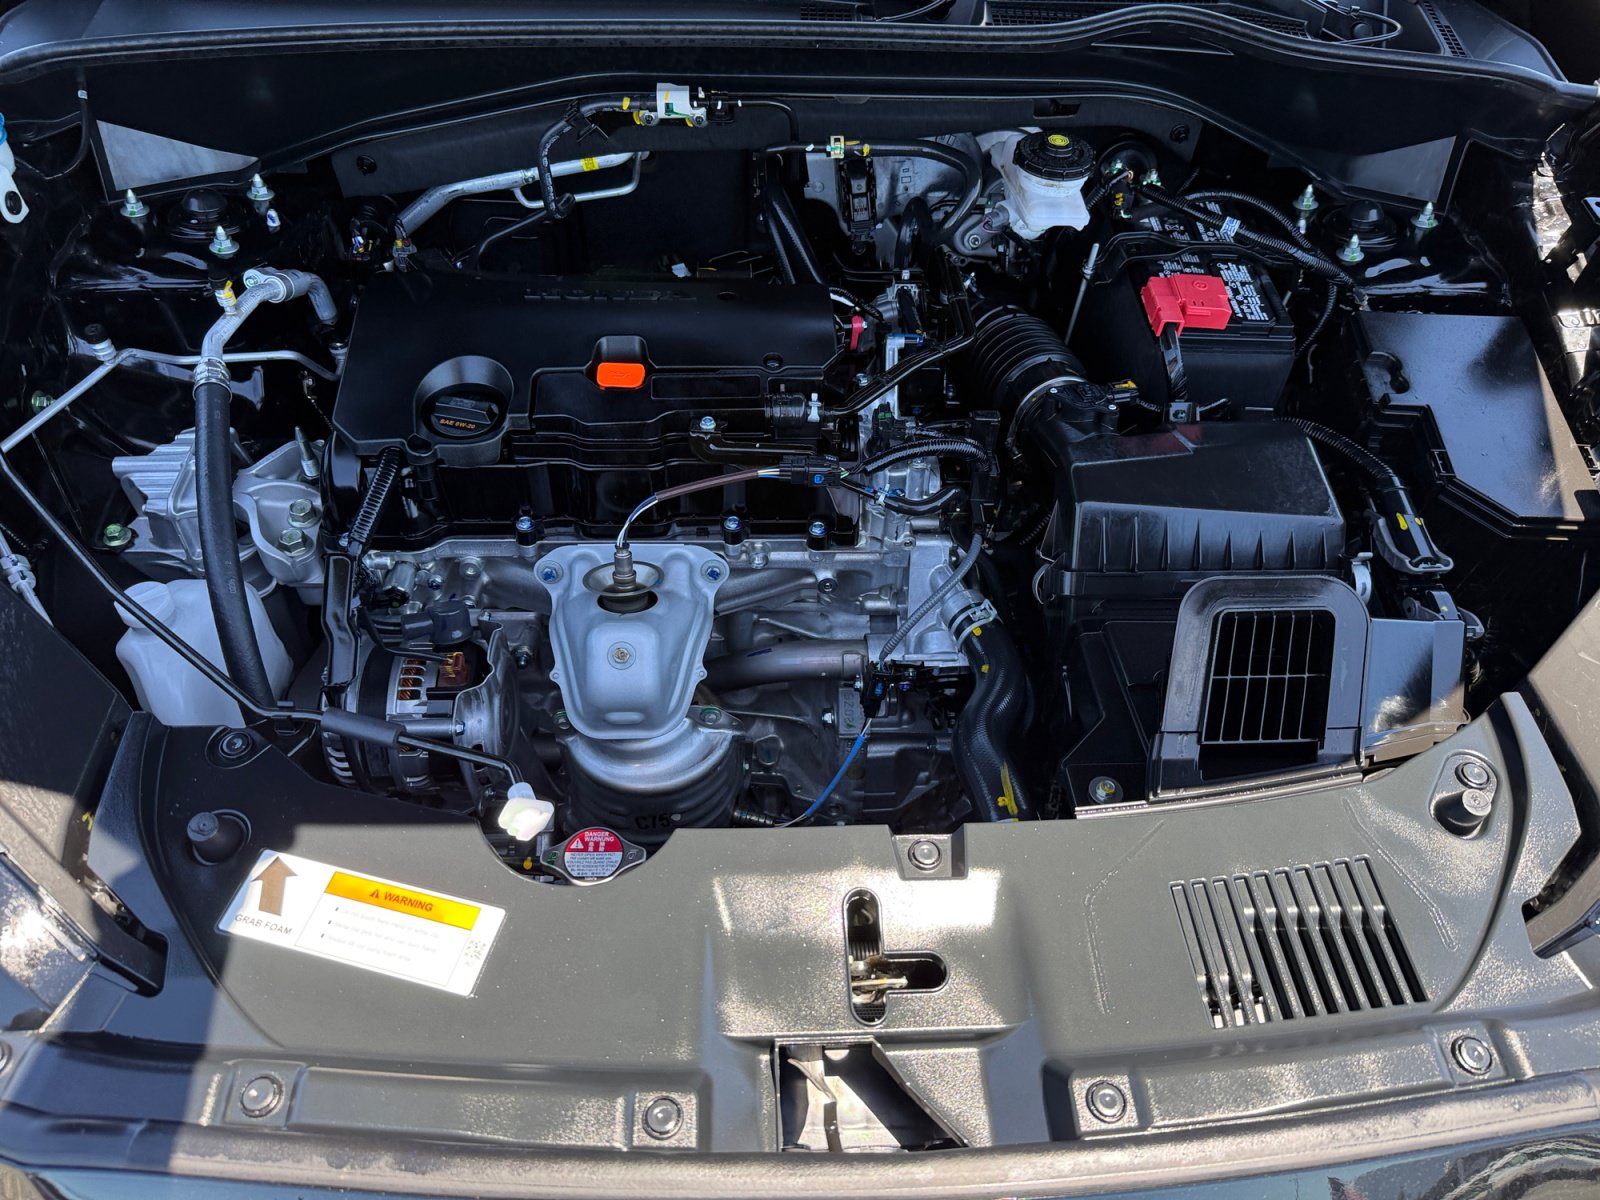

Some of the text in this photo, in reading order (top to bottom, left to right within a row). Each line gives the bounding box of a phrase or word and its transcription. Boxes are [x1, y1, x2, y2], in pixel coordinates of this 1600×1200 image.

[439, 418, 454, 427] SAE
[383, 891, 434, 913] WARNING
[234, 913, 293, 935] GRAB FOAM
